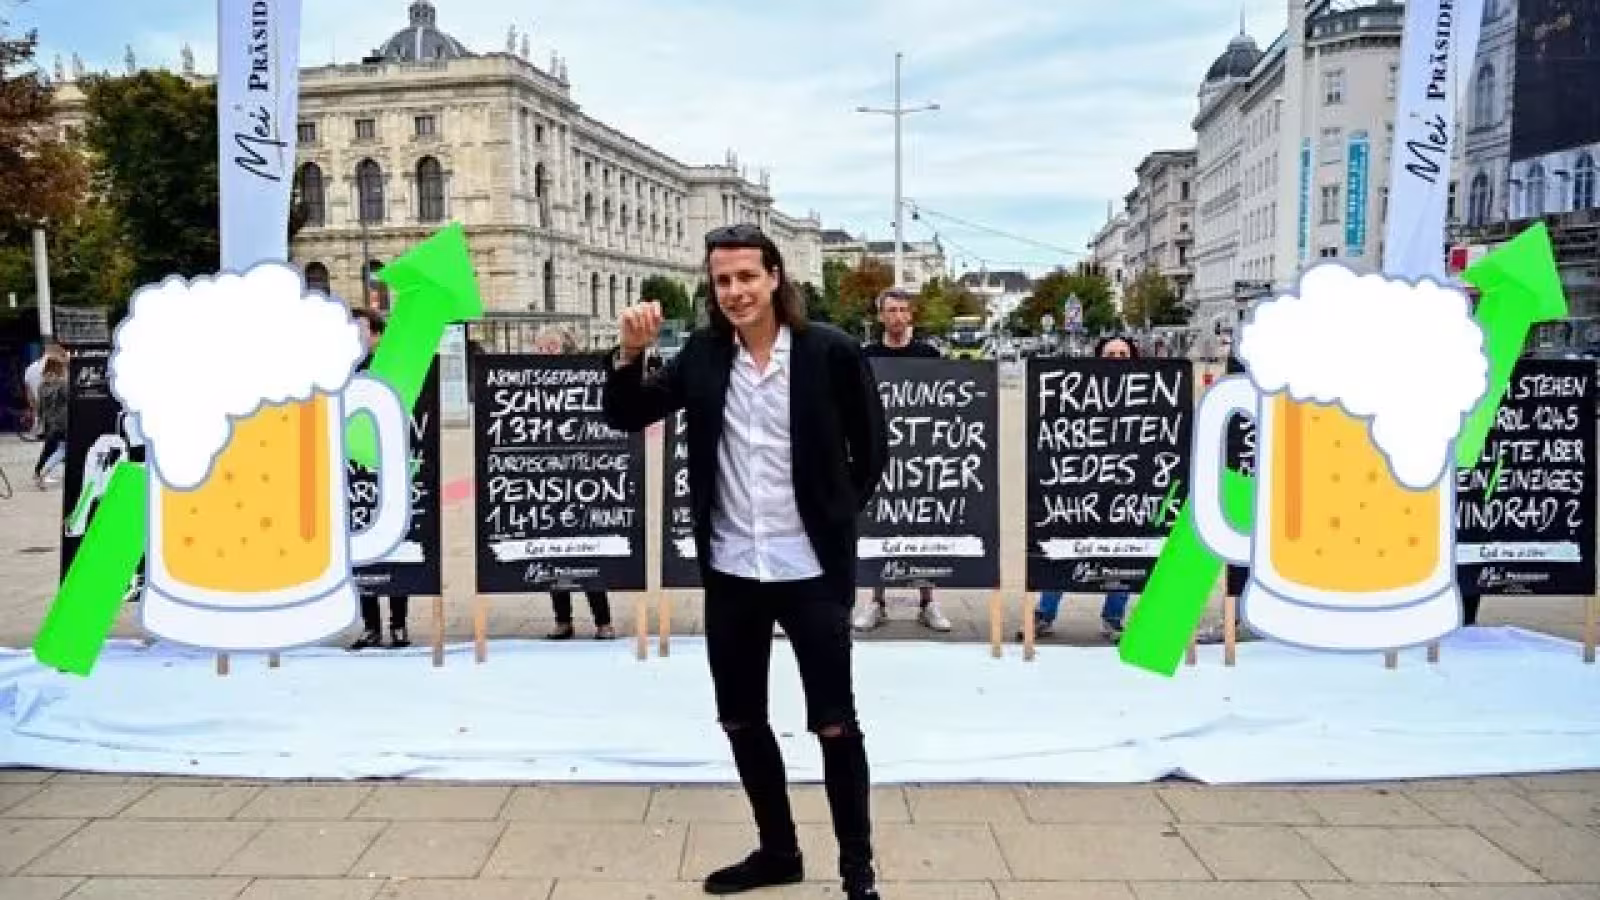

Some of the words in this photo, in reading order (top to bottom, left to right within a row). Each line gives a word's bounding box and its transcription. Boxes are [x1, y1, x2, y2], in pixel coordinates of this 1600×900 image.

[1039, 369, 1183, 417] FRAUEN
[1514, 373, 1588, 399] STEHEN
[932, 414, 987, 450] FÜR
[1037, 411, 1183, 451] ARBEITEN
[488, 472, 636, 502] PENSION:
[1039, 453, 1140, 485] JEDES
[1035, 491, 1101, 528] JAHR
